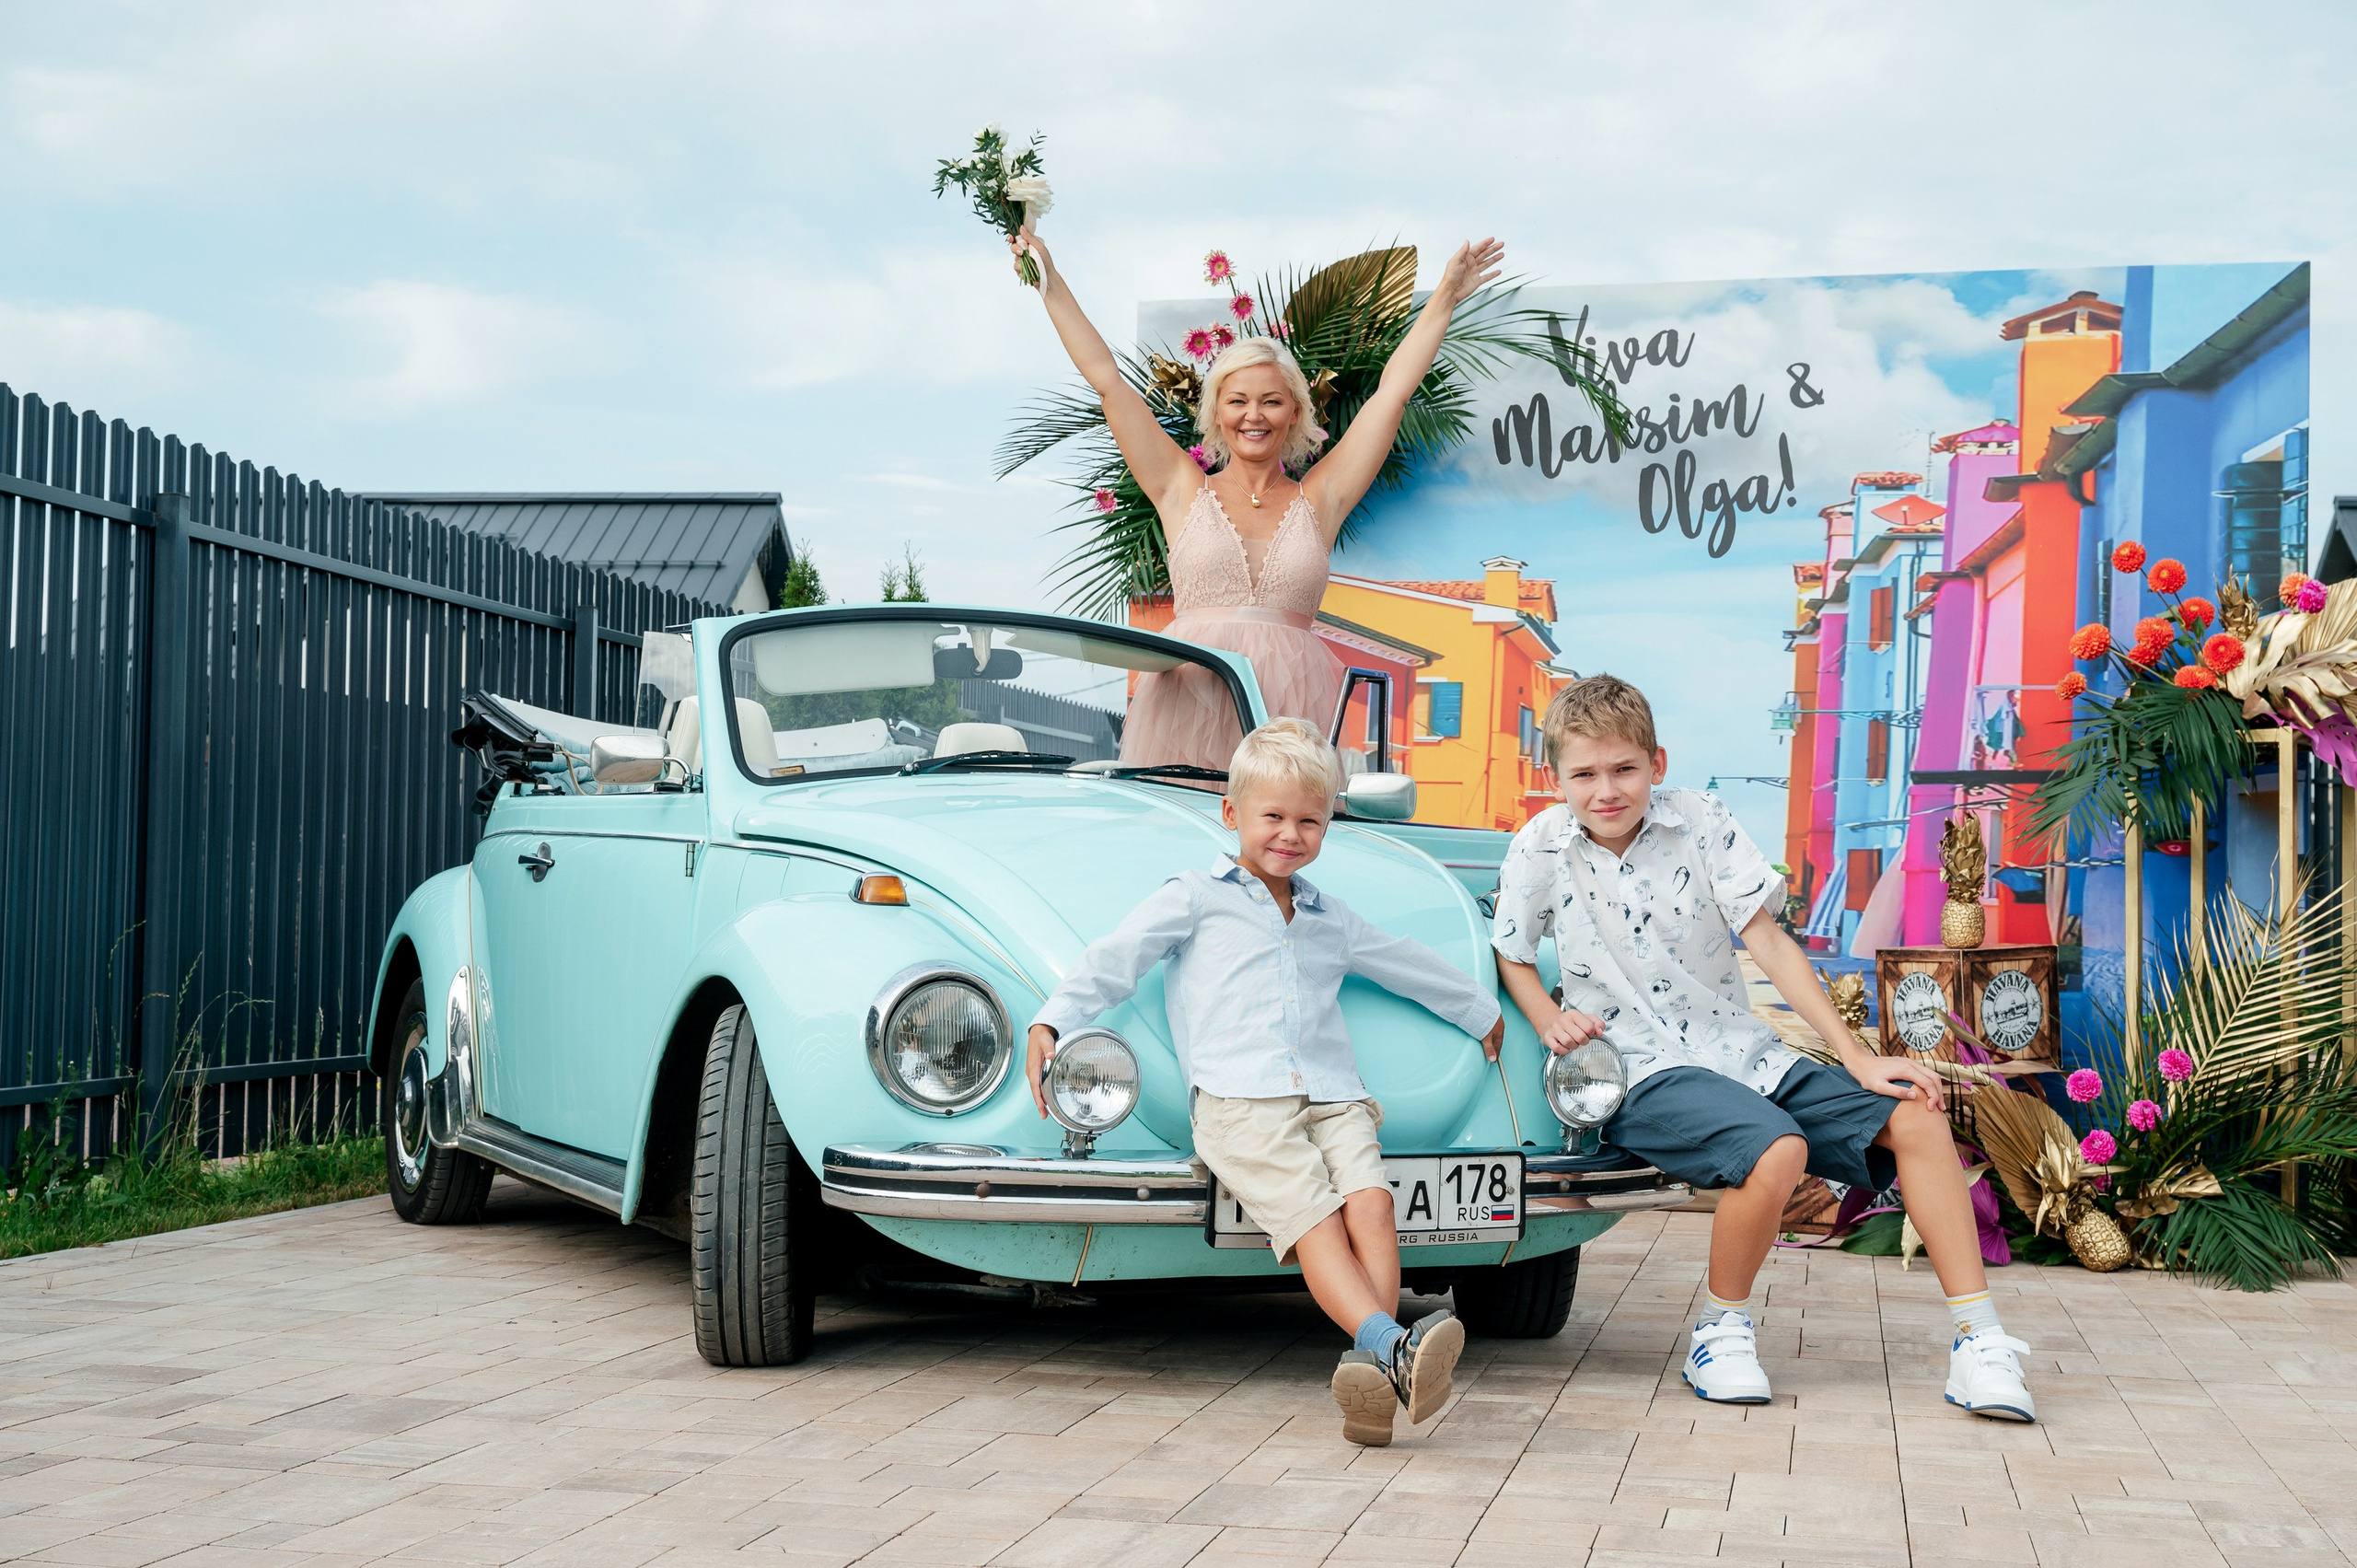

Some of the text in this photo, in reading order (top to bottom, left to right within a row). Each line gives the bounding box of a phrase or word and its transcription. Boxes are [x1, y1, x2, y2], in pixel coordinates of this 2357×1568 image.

[1548, 305, 1695, 388] Viva
[1786, 362, 1825, 408] &
[1639, 432, 1796, 558] Olga!
[1897, 976, 1935, 1002] HAVANA
[1985, 974, 2030, 1003] HAVANA
[1902, 1024, 1944, 1048] HAVANA
[1991, 1021, 2038, 1048] HAVANA
[1446, 1163, 1506, 1204] 178
[1387, 1180, 1432, 1220] A
[1457, 1206, 1490, 1222] RUS
[1399, 1232, 1479, 1244] RG RUSSIA
